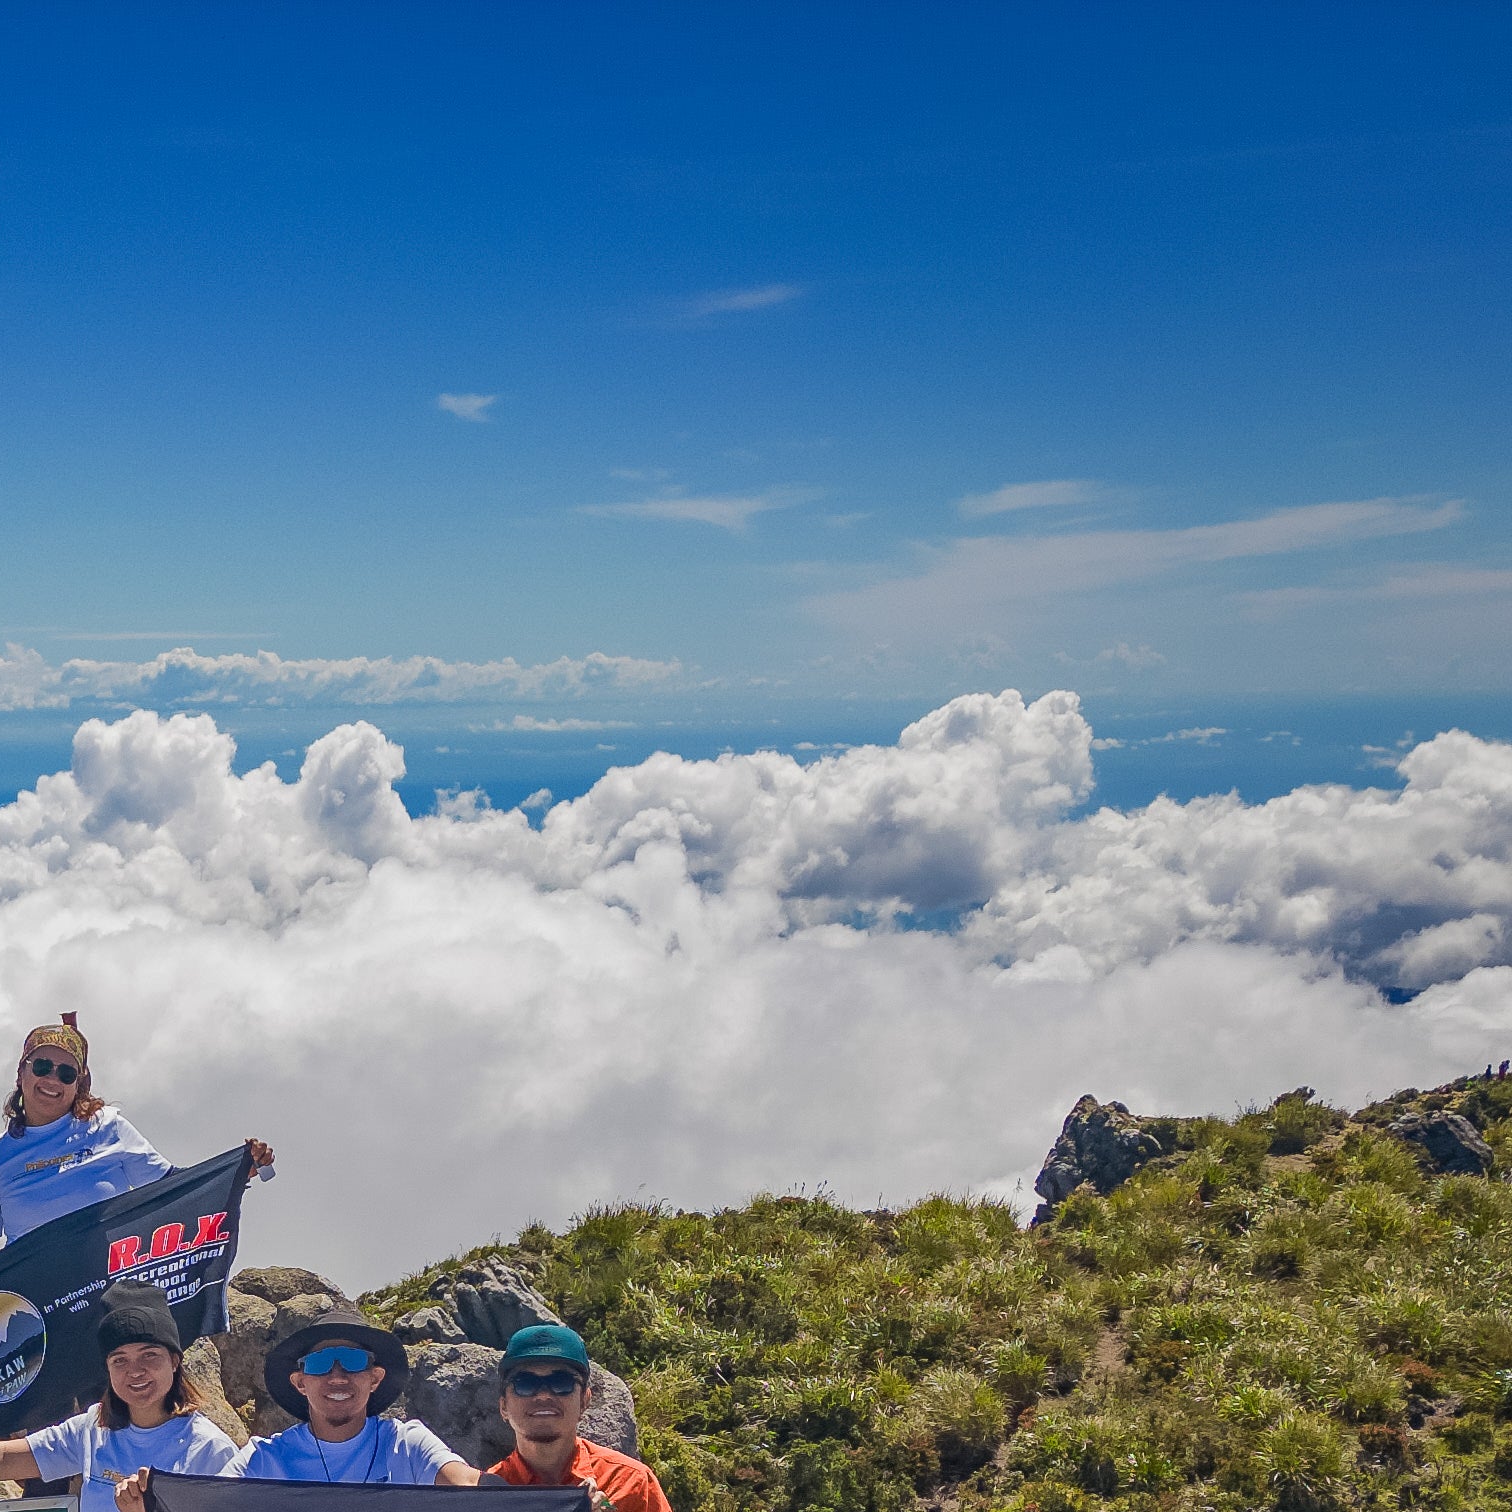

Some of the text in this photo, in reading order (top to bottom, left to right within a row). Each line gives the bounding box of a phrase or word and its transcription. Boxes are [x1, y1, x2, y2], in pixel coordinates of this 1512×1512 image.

[107, 1211, 230, 1275] R.O.X.
[115, 1244, 225, 1283] creational
[43, 1279, 107, 1314] In Partnership
[166, 1277, 201, 1300] ange
[68, 1299, 90, 1313] with
[4, 1372, 27, 1393] PAW
